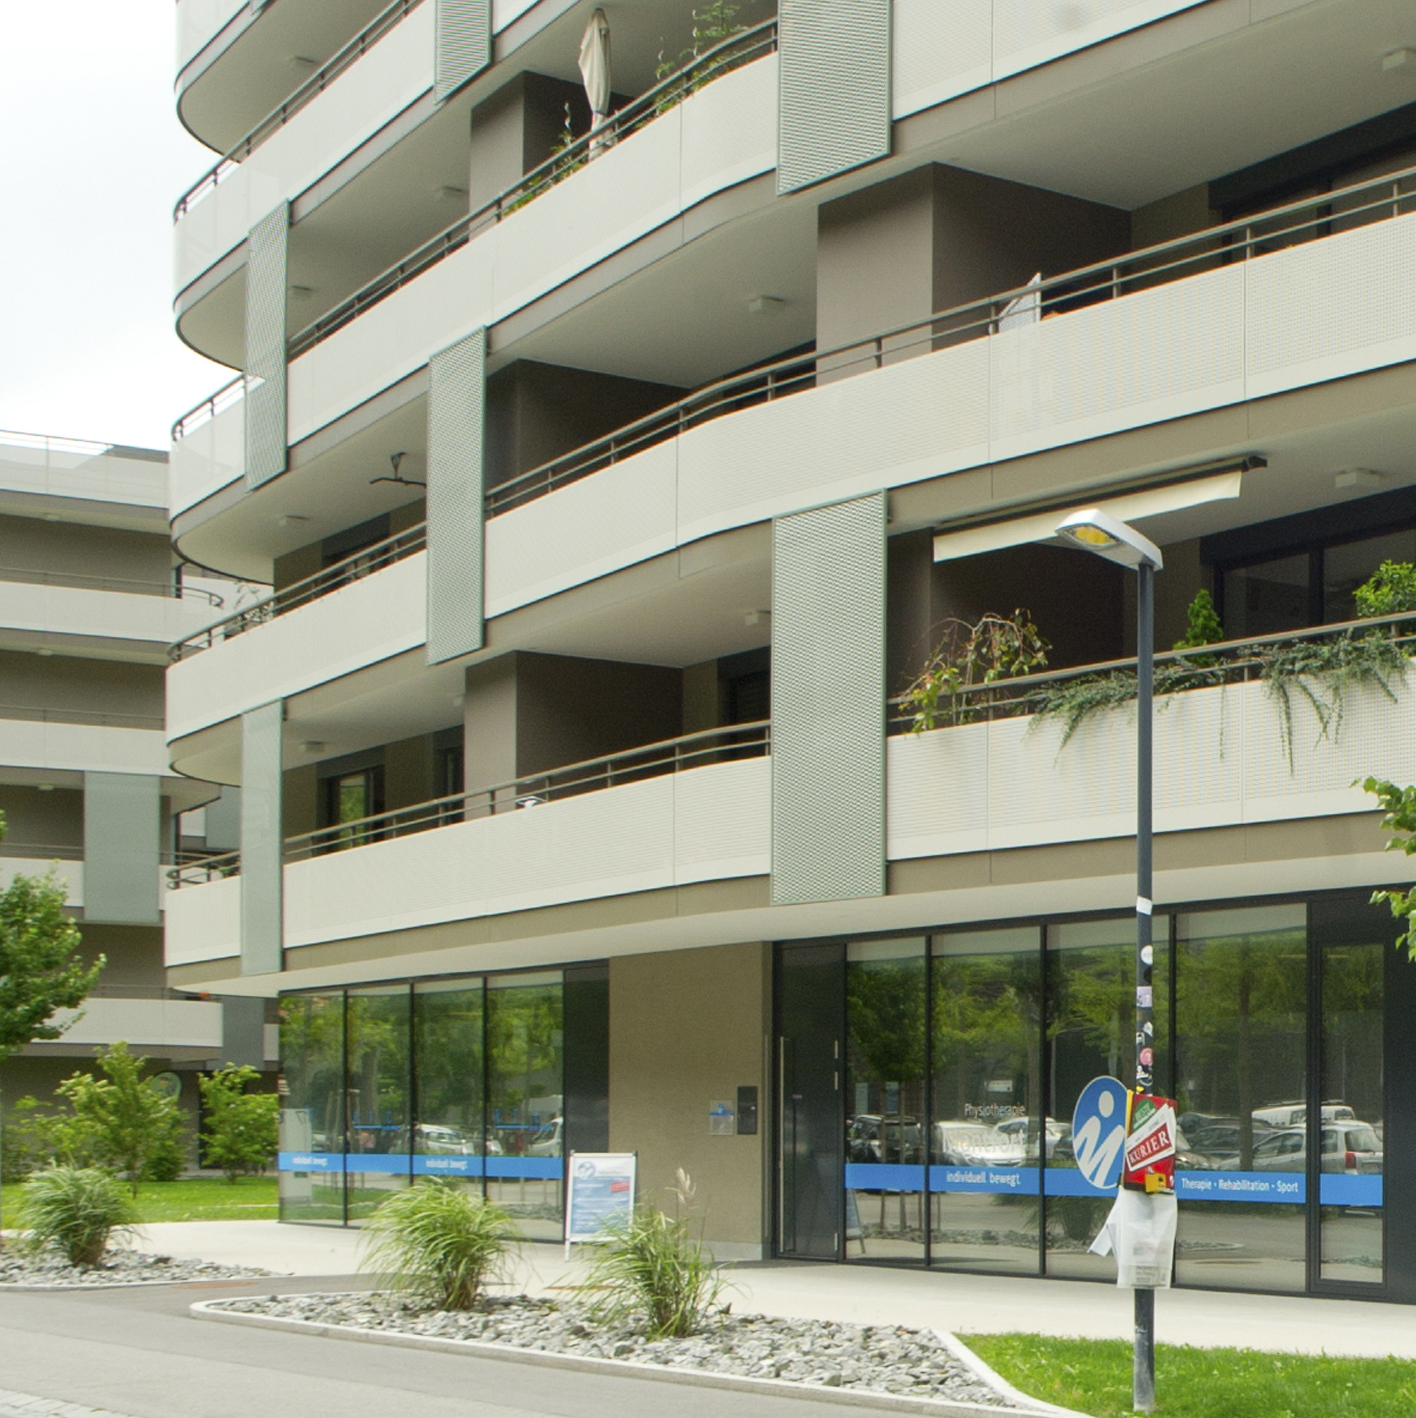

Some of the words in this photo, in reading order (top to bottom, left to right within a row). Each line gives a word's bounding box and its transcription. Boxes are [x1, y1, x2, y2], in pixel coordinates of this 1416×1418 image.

[1128, 1130, 1170, 1164] KURIER
[946, 1170, 986, 1184] individuell
[989, 1171, 1022, 1188] bewegt
[1181, 1177, 1212, 1191] Therapie
[1218, 1179, 1270, 1191] Rehabilitation
[1277, 1180, 1299, 1194] Sport
